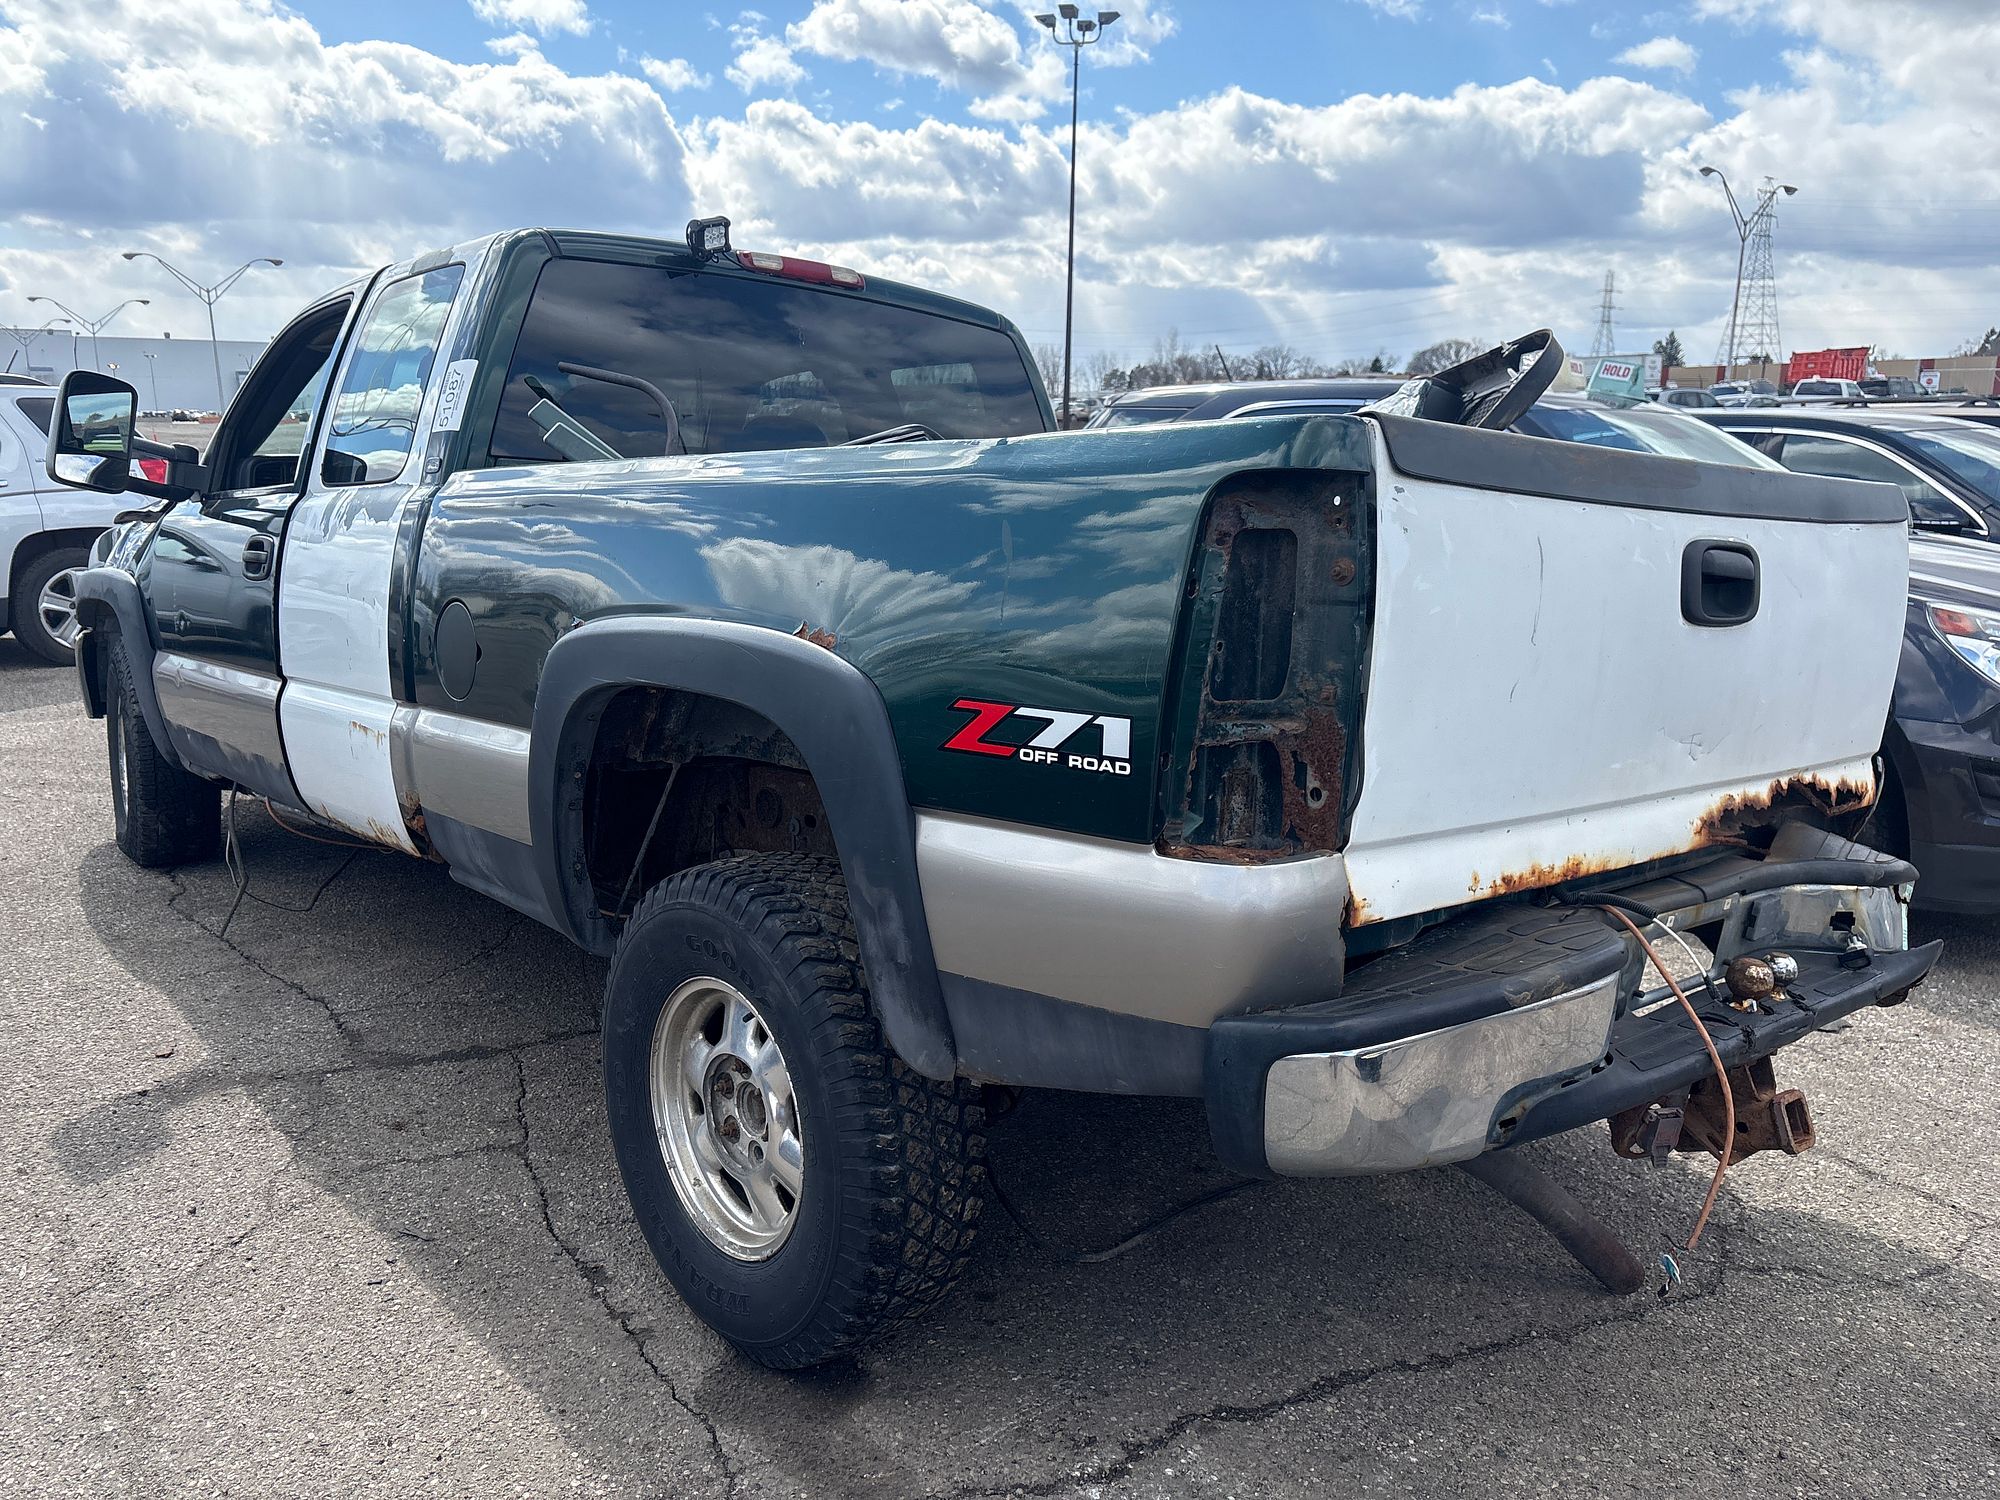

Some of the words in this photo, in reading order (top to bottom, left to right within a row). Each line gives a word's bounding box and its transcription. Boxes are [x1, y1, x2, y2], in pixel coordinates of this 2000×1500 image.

[1602, 363, 1631, 379] HOLD
[439, 368, 461, 428] 51087
[944, 699, 1131, 759] Z71
[1019, 748, 1058, 765] OFF
[1068, 754, 1132, 776] ROAD
